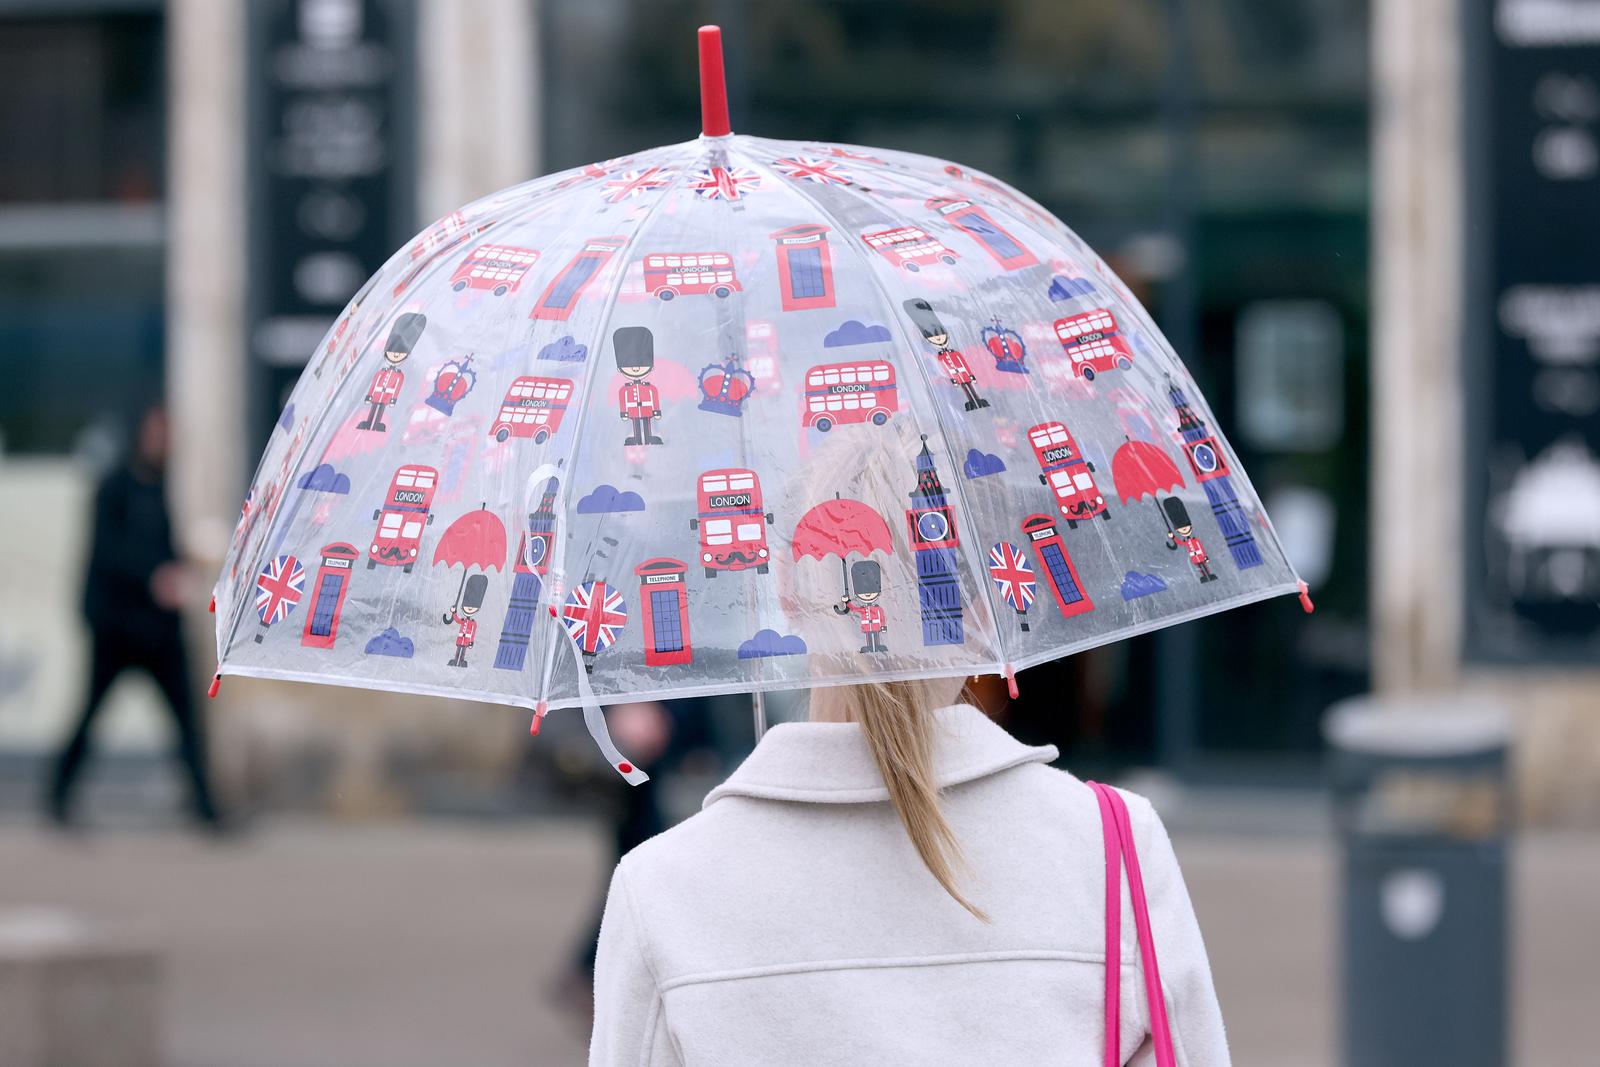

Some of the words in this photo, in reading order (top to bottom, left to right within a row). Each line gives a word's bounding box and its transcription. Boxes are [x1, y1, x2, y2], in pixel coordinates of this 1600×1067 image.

[674, 265, 709, 273] LONDON
[1079, 332, 1103, 344] LONDON
[832, 384, 866, 393] LONDON
[520, 399, 548, 408] LONDON
[1043, 447, 1073, 462] LONDON
[394, 491, 425, 503] LONDON
[710, 494, 750, 507] LONDON
